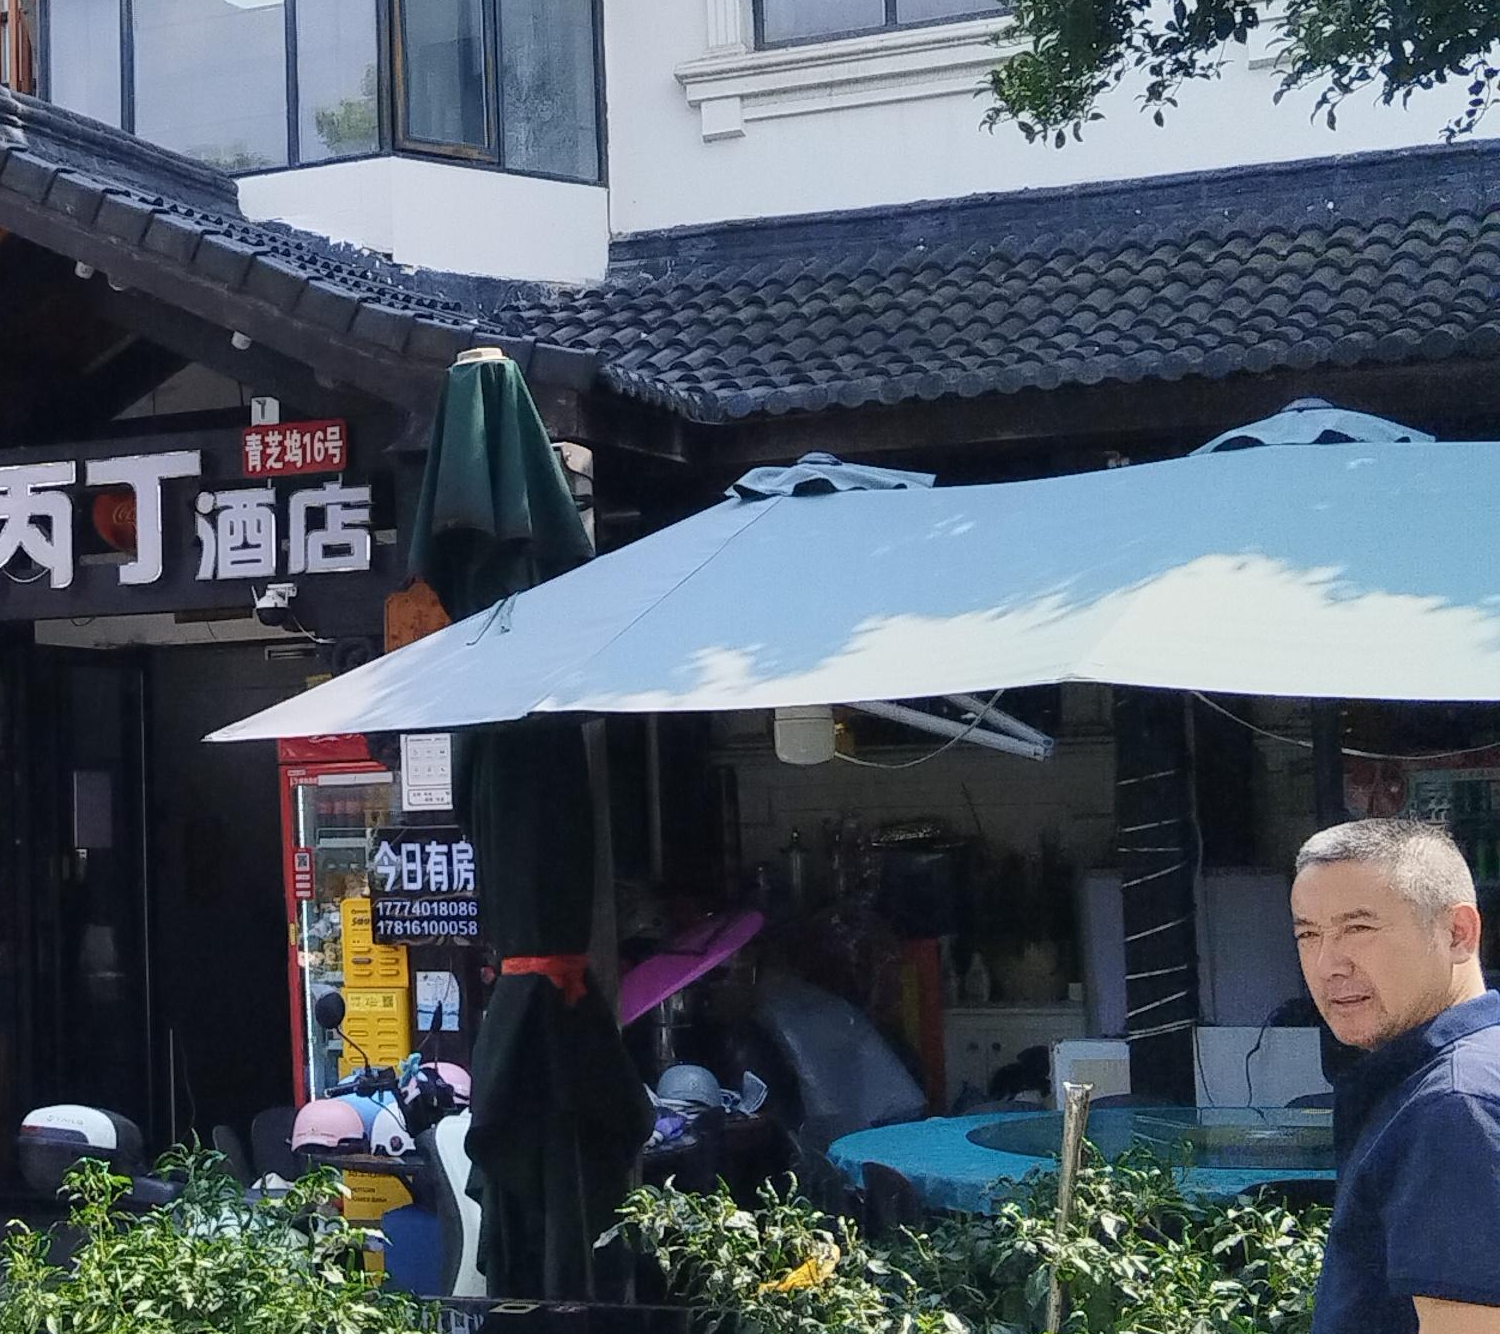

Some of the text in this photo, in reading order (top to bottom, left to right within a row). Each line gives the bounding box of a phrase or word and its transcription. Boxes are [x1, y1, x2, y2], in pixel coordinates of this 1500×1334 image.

[245, 425, 343, 472] 青芝坞16号
[374, 840, 475, 892] 今日有房
[376, 901, 478, 917] 17774018086
[377, 920, 478, 935] 17816100058
